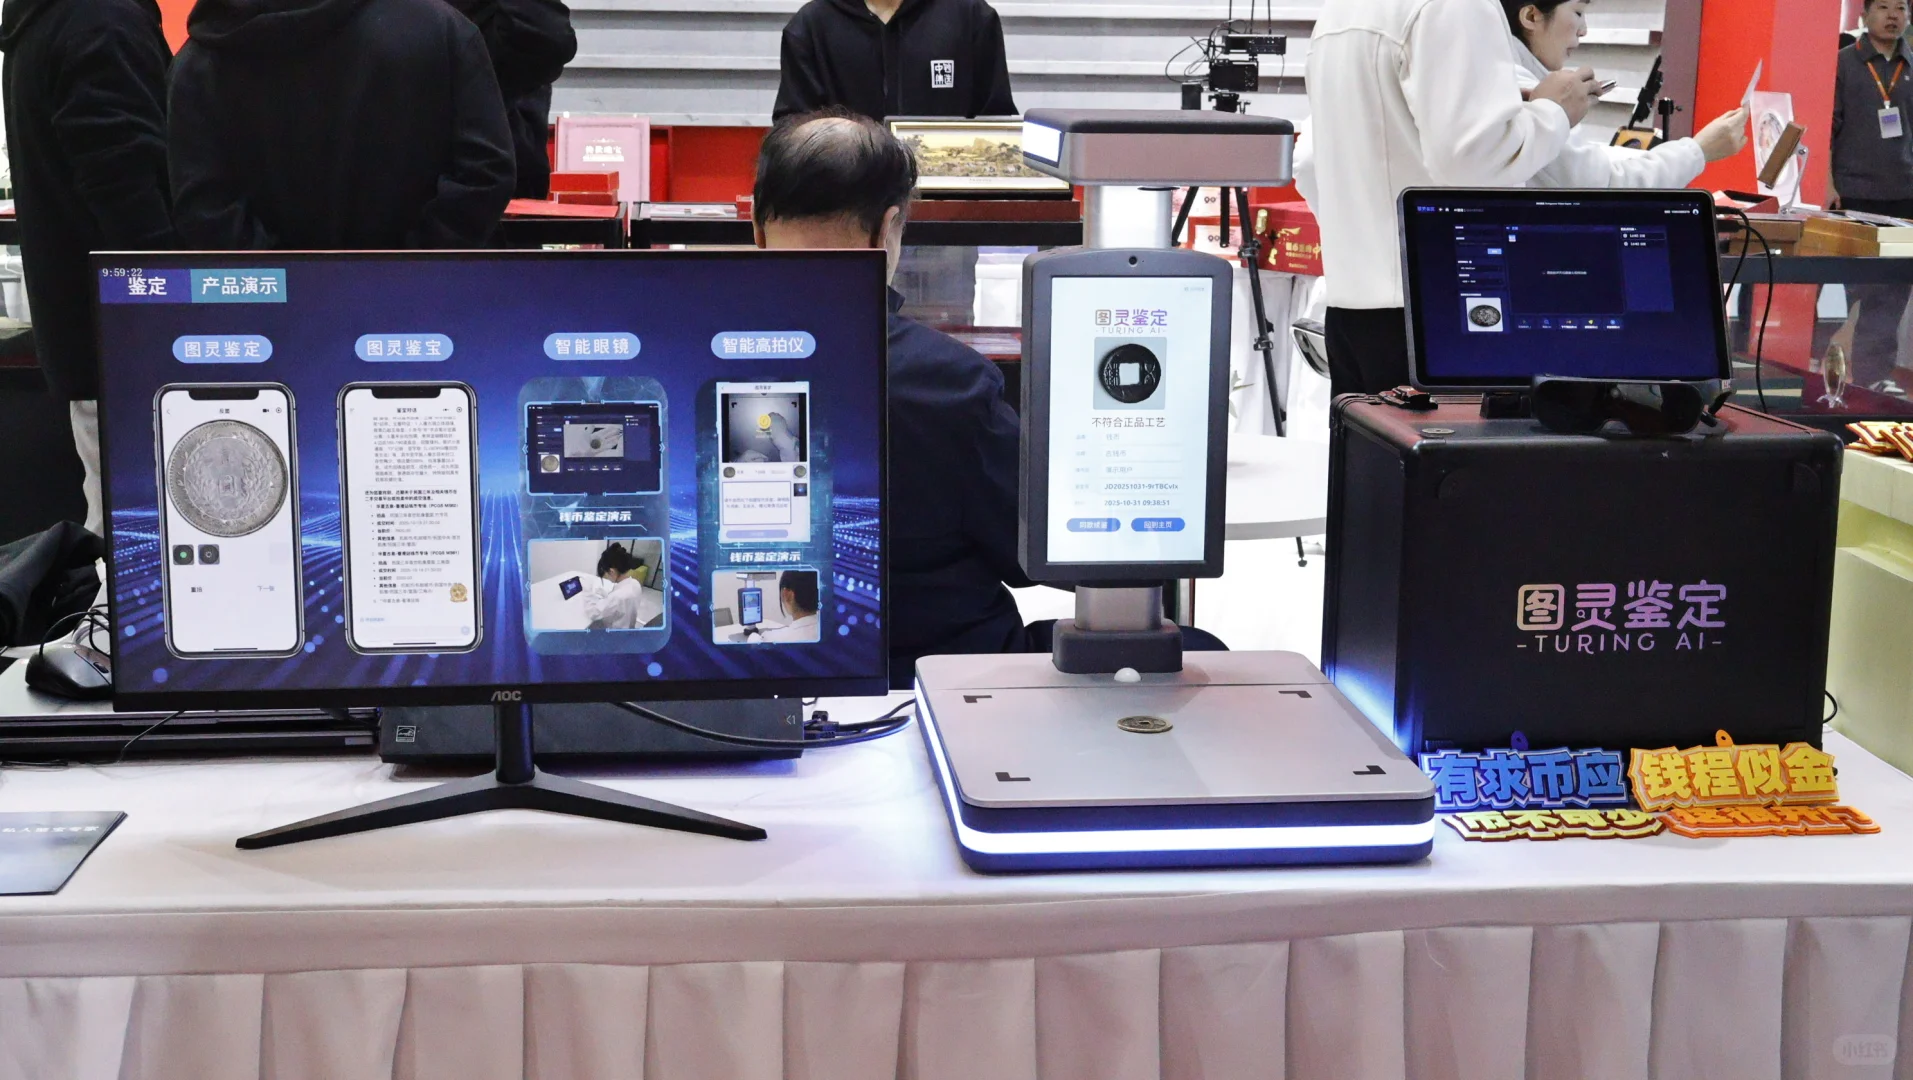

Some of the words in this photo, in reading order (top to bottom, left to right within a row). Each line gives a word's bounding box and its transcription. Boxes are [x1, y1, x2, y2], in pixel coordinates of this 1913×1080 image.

[102, 268, 143, 278] 9:59:22
[128, 277, 167, 296] 鉴定
[202, 276, 278, 296] 产品演示
[1095, 309, 1168, 326] 图灵鉴定
[184, 341, 261, 358] 图灵鉴定
[366, 340, 442, 356] 图灵鉴宝
[555, 338, 630, 355] 智能眼镜
[722, 337, 804, 354] 智能高拍仪
[1092, 417, 1166, 428] 不符合正品工艺
[559, 511, 632, 523] 钱币鉴定演示
[1144, 521, 1172, 529] 回到主页
[730, 551, 801, 563] 钱币鉴定演示
[1516, 580, 1727, 632] 图灵鉴定
[491, 690, 522, 701] AOC
[1430, 752, 1626, 801] 有求币应
[1644, 751, 1836, 796] 钱程似金
[1456, 808, 1654, 830] 币不可少
